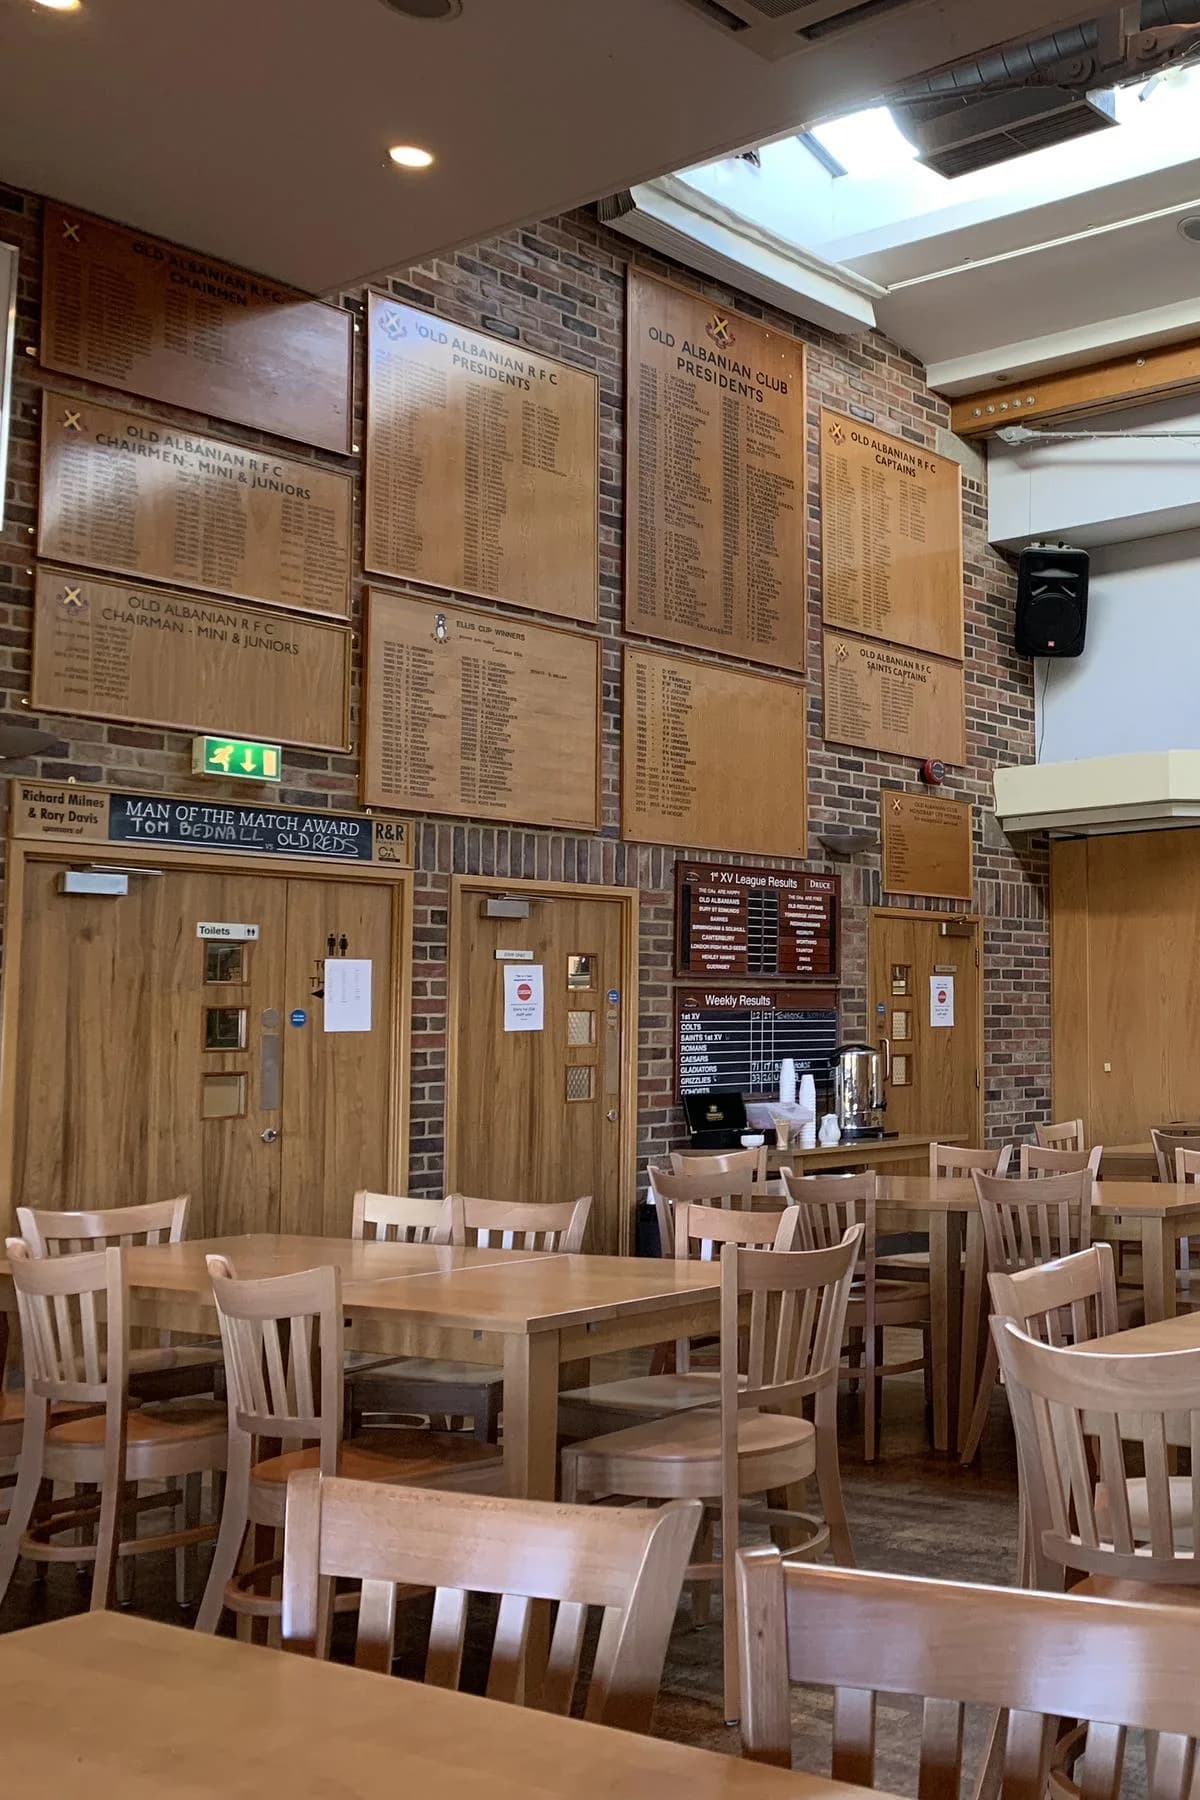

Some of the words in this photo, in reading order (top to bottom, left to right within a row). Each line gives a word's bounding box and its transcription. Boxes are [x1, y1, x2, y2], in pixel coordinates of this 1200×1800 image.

[133, 242, 163, 260] OLD
[169, 256, 246, 290] ALBANIAN
[170, 272, 247, 306] CHAIRMEN
[452, 338, 524, 373] ALBANIAN
[648, 327, 675, 348] OLD
[682, 341, 751, 380] ALBANIAN
[756, 372, 788, 395] CLUB
[453, 354, 530, 391] PRESIDENTS
[677, 357, 764, 403] PRESIDENTS
[127, 426, 160, 443] OLD
[164, 436, 244, 467] ALBANIAN
[851, 432, 869, 446] OLD
[871, 440, 915, 465] ALBANIAN
[95, 434, 184, 466] CHAIRMEN
[198, 460, 233, 479] MINI
[238, 471, 248, 483] &
[251, 472, 311, 500] JUNIORS
[875, 454, 916, 478] CAPTAINS
[128, 596, 160, 612] OLD
[164, 604, 237, 628] ALBANIAN
[102, 608, 184, 633] CHAIRMAN
[197, 626, 227, 641] MINI
[232, 633, 241, 644] &
[244, 635, 299, 656] JUNIORS
[456, 620, 475, 630] ELLIS
[478, 625, 493, 633] CUP
[495, 628, 525, 641] WINNERS
[860, 649, 875, 659] OLD
[877, 653, 914, 669] ALBANIAN
[867, 661, 892, 674] SAINTS
[893, 668, 927, 683] CAPTAINS
[22, 789, 65, 804] Richard
[68, 794, 105, 808] Milnes
[28, 807, 36, 818] &
[40, 808, 65, 824] Rory
[68, 810, 98, 824] Davis
[125, 801, 171, 819] MAN
[175, 805, 199, 821] OF
[201, 807, 235, 825] THE
[239, 811, 298, 831] MATCH
[302, 818, 360, 837] AWARD
[130, 817, 169, 834] TOM
[180, 821, 263, 842] BEDNALL
[376, 823, 404, 841] R&R
[277, 833, 310, 849] OLD
[313, 833, 358, 854] REDS
[710, 871, 719, 882] 1st
[720, 872, 734, 884] XV
[735, 873, 767, 888] League
[768, 877, 798, 889] Results
[199, 925, 231, 936] Toilets
[705, 994, 738, 1008] Weekly
[739, 995, 771, 1006] Results
[691, 1012, 701, 1020] XV
[681, 1023, 702, 1031] COLTS
[681, 1034, 703, 1042] SAINTS
[681, 1044, 707, 1053] ROMANS
[681, 1055, 709, 1063] CAESARS
[680, 1066, 718, 1074] GLADIATORS
[681, 1076, 712, 1085] GRIZZLIES
